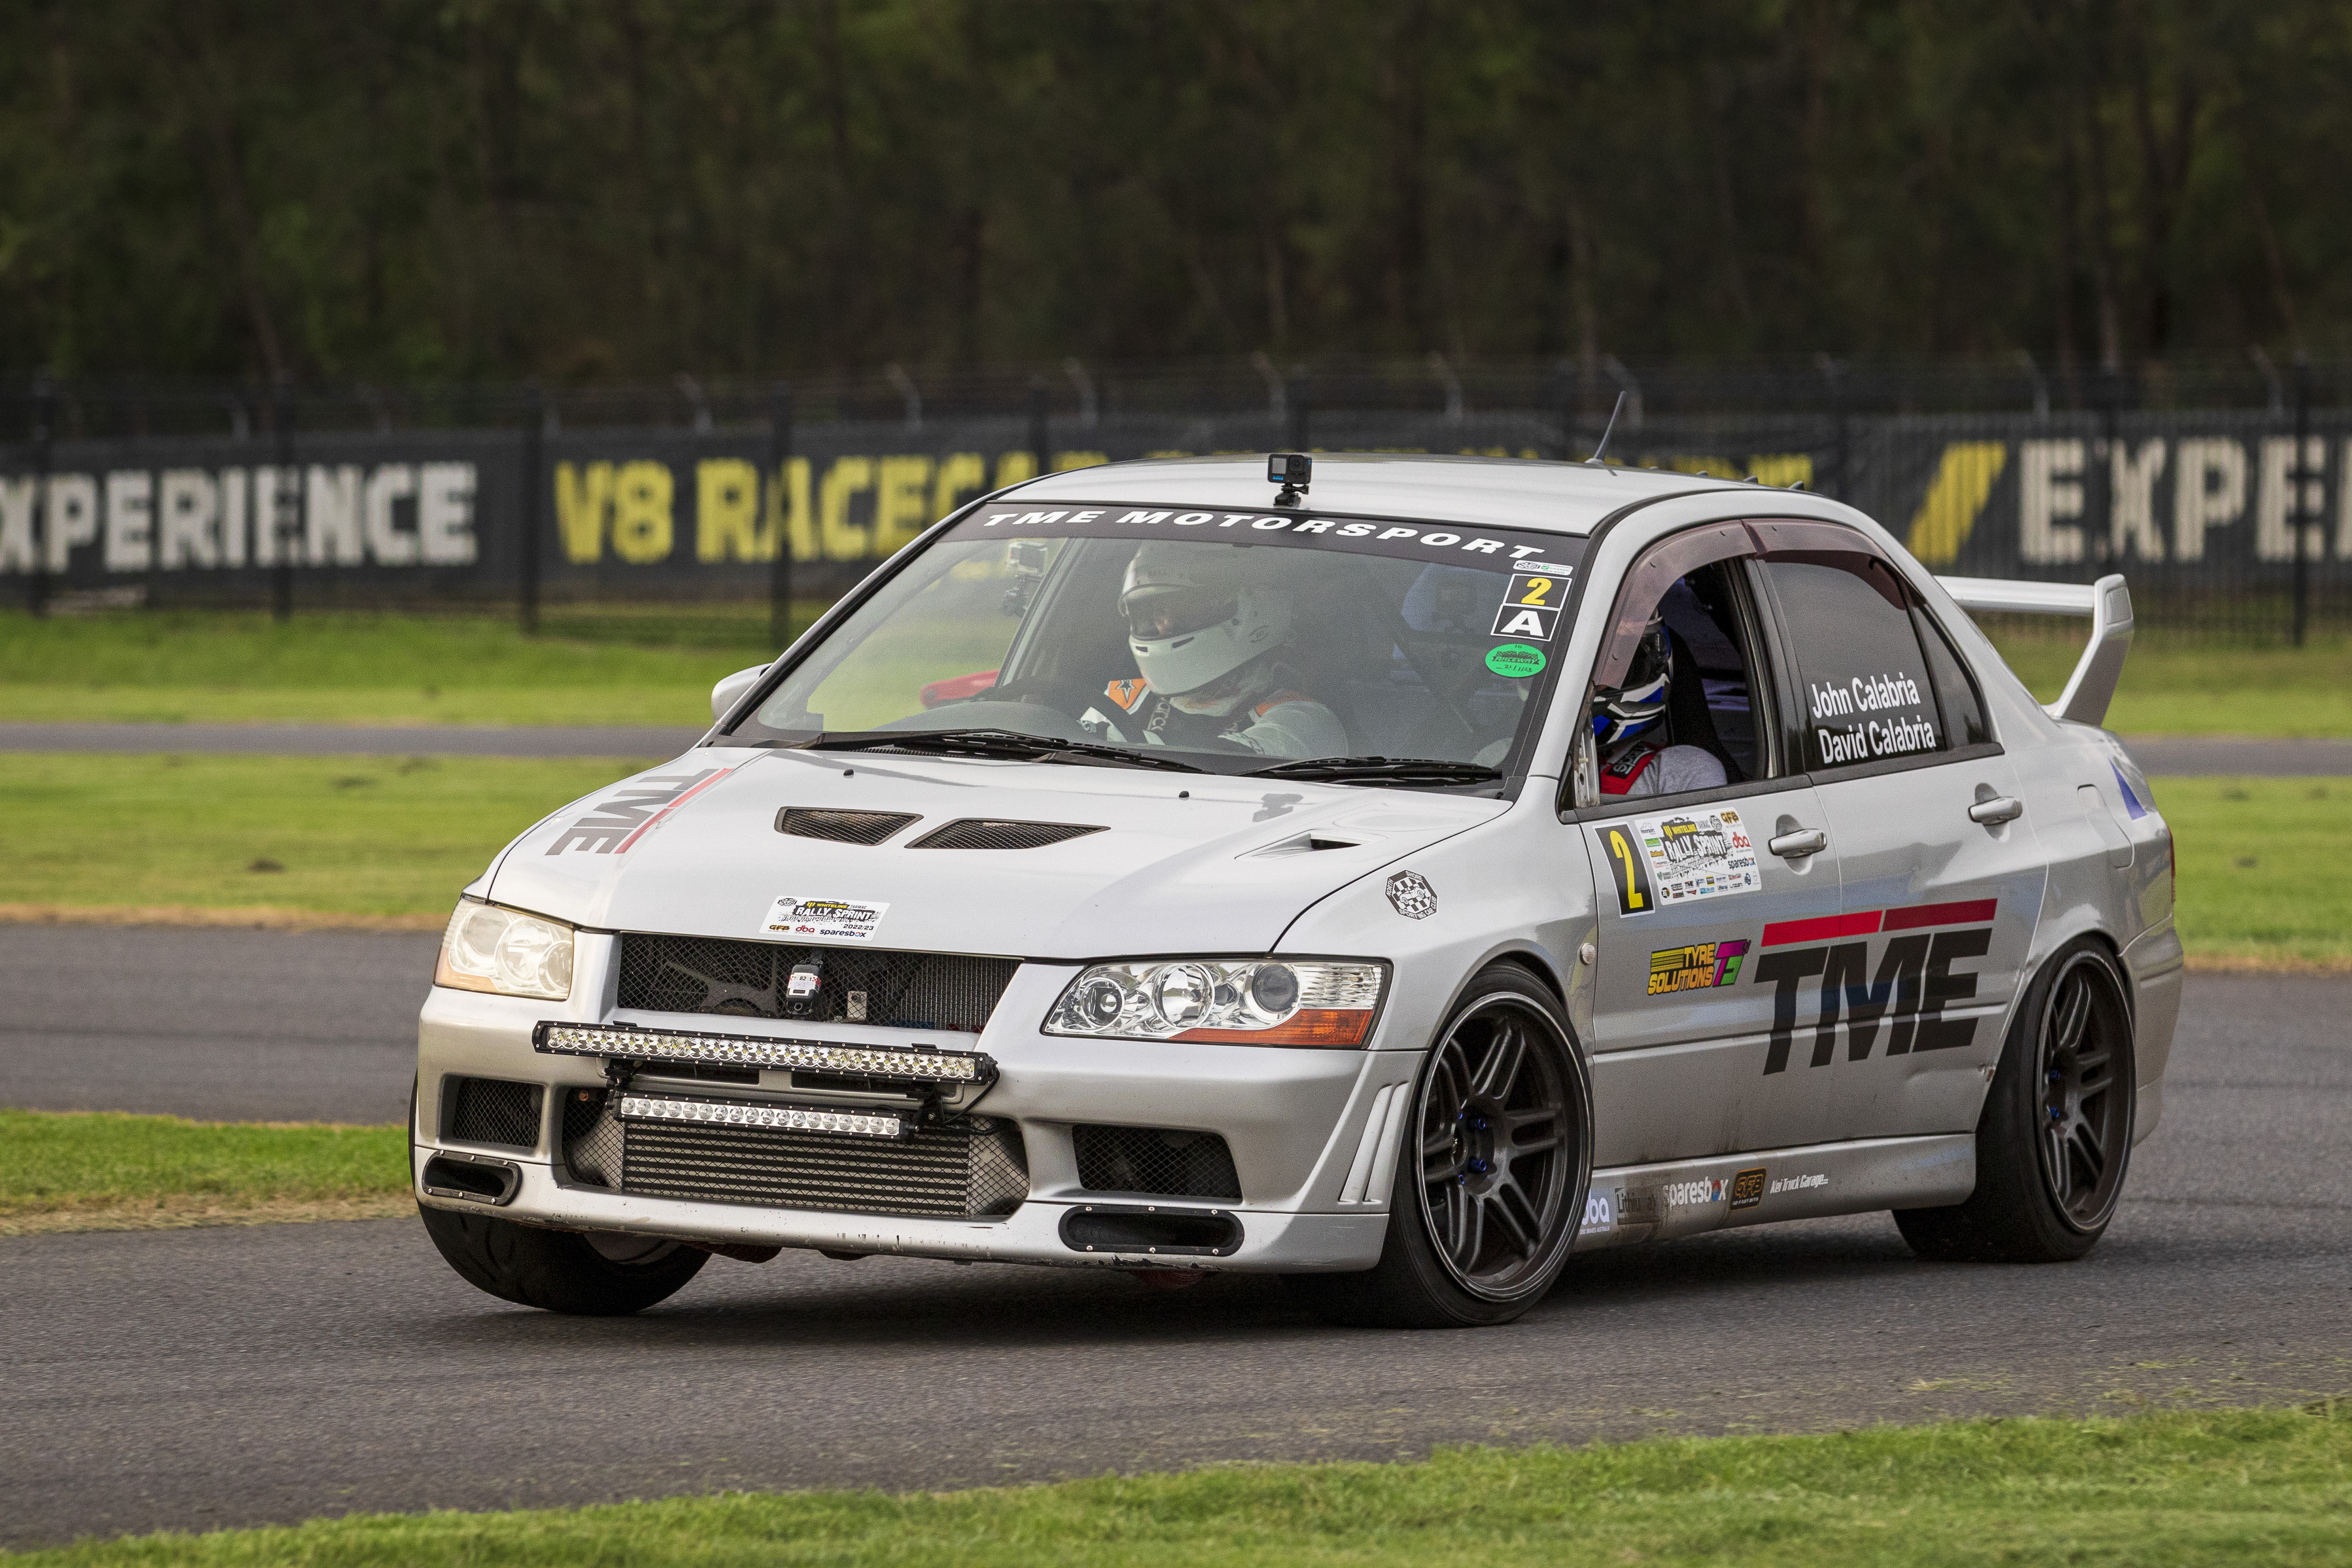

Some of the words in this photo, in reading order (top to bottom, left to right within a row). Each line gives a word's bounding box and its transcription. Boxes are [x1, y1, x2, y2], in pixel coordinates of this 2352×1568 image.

[554, 459, 674, 564] V8
[696, 451, 1109, 562] RACEC
[2020, 437, 2352, 562] EXPE
[983, 510, 1107, 527] TME
[1115, 510, 1546, 559] MOTORSPORT
[1521, 577, 1552, 605] 2
[1500, 610, 1544, 637] A
[1812, 682, 1854, 719] John
[1852, 672, 1921, 712] Calabria
[1818, 723, 1869, 764] David
[1869, 715, 1936, 756] Calabria
[545, 768, 720, 856] TME
[1671, 823, 1698, 835] WHITELINE
[1732, 831, 1750, 848] dba
[1664, 835, 1694, 862] RALLY
[1693, 834, 1727, 857] SPRINT
[1609, 830, 1644, 909] 2
[1727, 857, 1756, 870] sparesbox
[1385, 878, 1394, 897] NORTH
[1405, 870, 1424, 882] SHORE
[795, 907, 832, 916] RALLY
[832, 908, 873, 920] SPRINT
[1399, 908, 1426, 919] SPORTING
[820, 929, 867, 937] sparesbox
[1683, 942, 1716, 968] TYRE
[1647, 966, 1715, 996] SOLUTIONS
[1753, 927, 1993, 1076] TME
[1662, 1176, 1729, 1210] sparesbox
[1735, 1174, 1763, 1198] GFB
[1770, 1179, 1783, 1194] Kei
[1782, 1176, 1801, 1192] Truck
[1799, 1174, 1826, 1188] Garage
